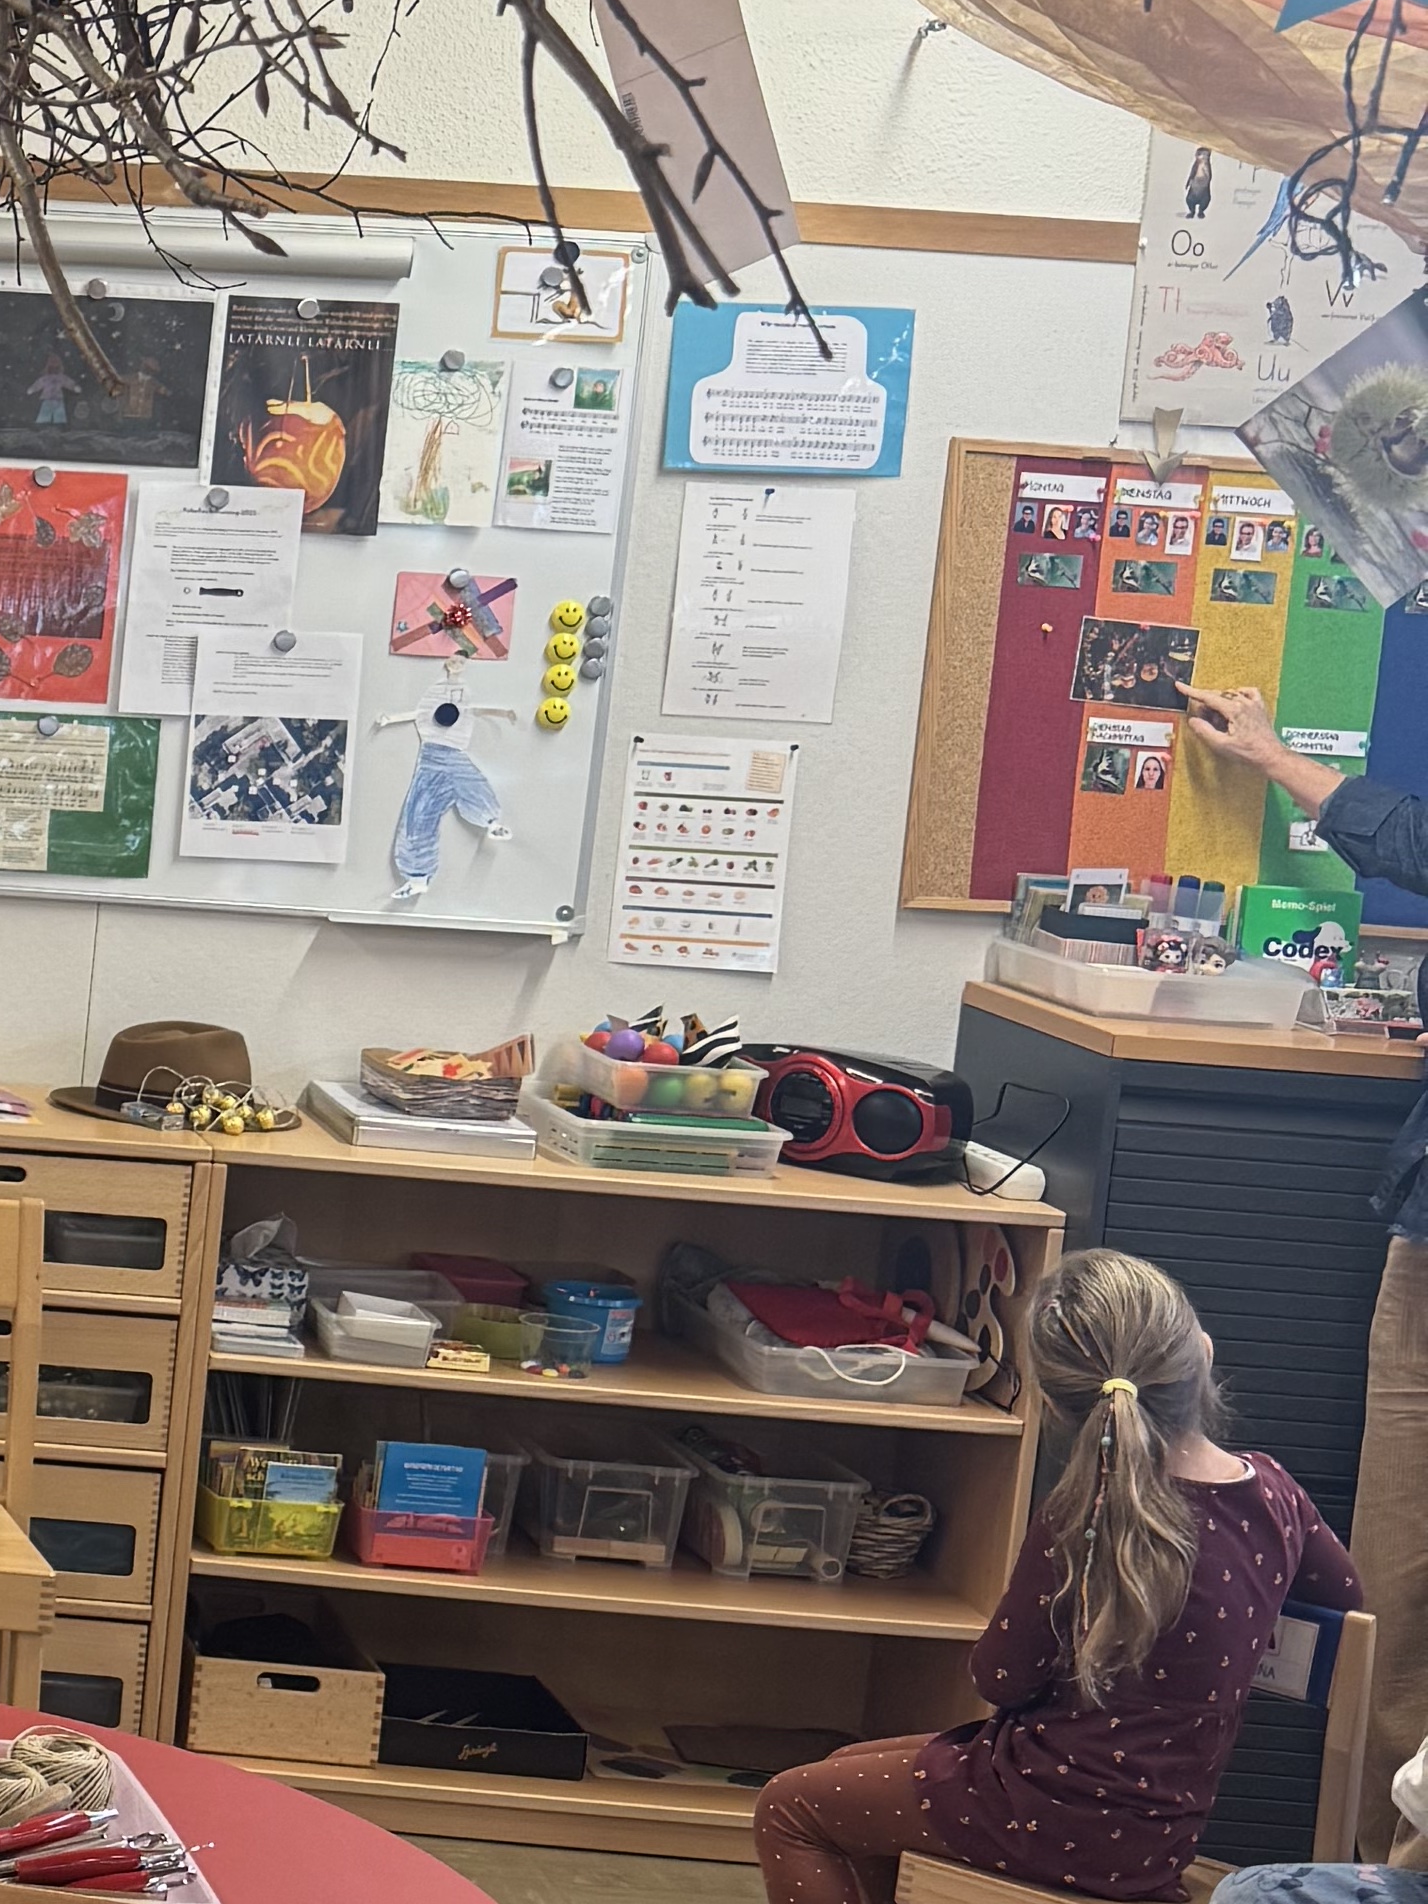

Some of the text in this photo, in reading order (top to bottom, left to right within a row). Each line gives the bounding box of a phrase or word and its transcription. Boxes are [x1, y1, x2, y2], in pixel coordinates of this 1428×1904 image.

[1170, 228, 1205, 258] Oo
[1256, 354, 1291, 383] Uu
[1271, 898, 1337, 913] Memo-Spiel
[1262, 936, 1344, 960] Codex
